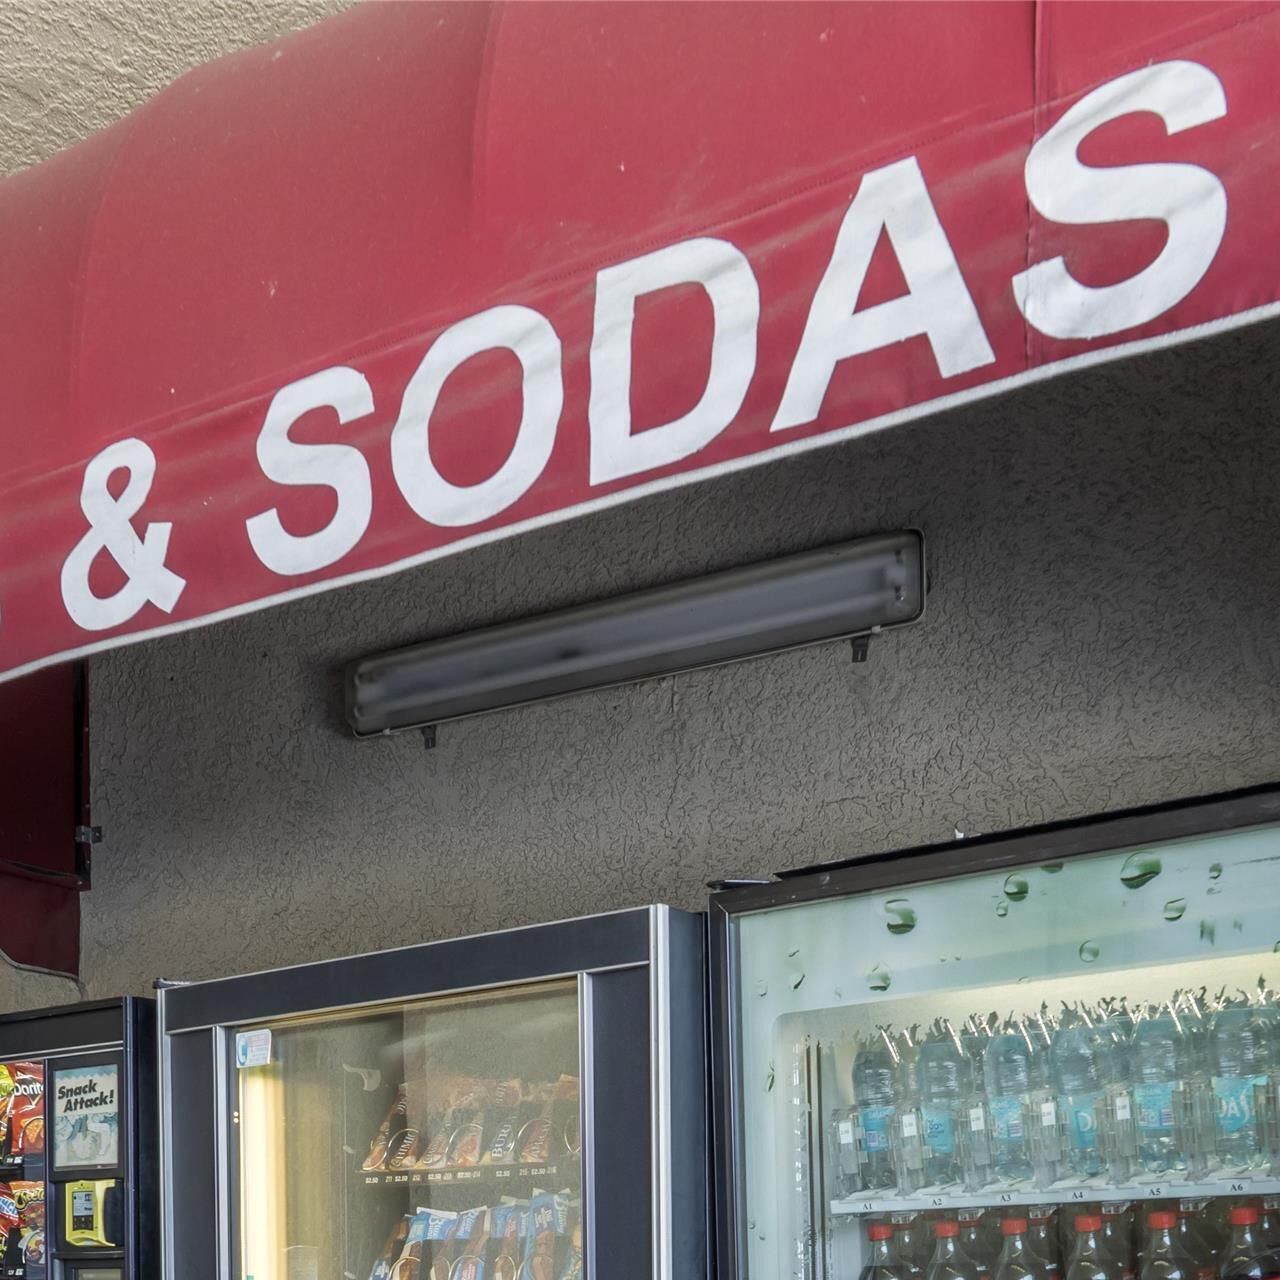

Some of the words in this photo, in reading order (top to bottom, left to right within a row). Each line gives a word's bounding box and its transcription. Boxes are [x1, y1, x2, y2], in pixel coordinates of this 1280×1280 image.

[60, 437, 187, 632] &
[245, 60, 1227, 575] SODAS
[15, 1081, 44, 1096] Dorit
[58, 1079, 98, 1100] Snack
[63, 1089, 115, 1113] Attack!
[931, 1198, 942, 1206] A2
[1000, 1194, 1012, 1202] A3
[1071, 1191, 1083, 1200] A4
[1148, 1187, 1161, 1196] A5
[1230, 1183, 1243, 1192] A6
